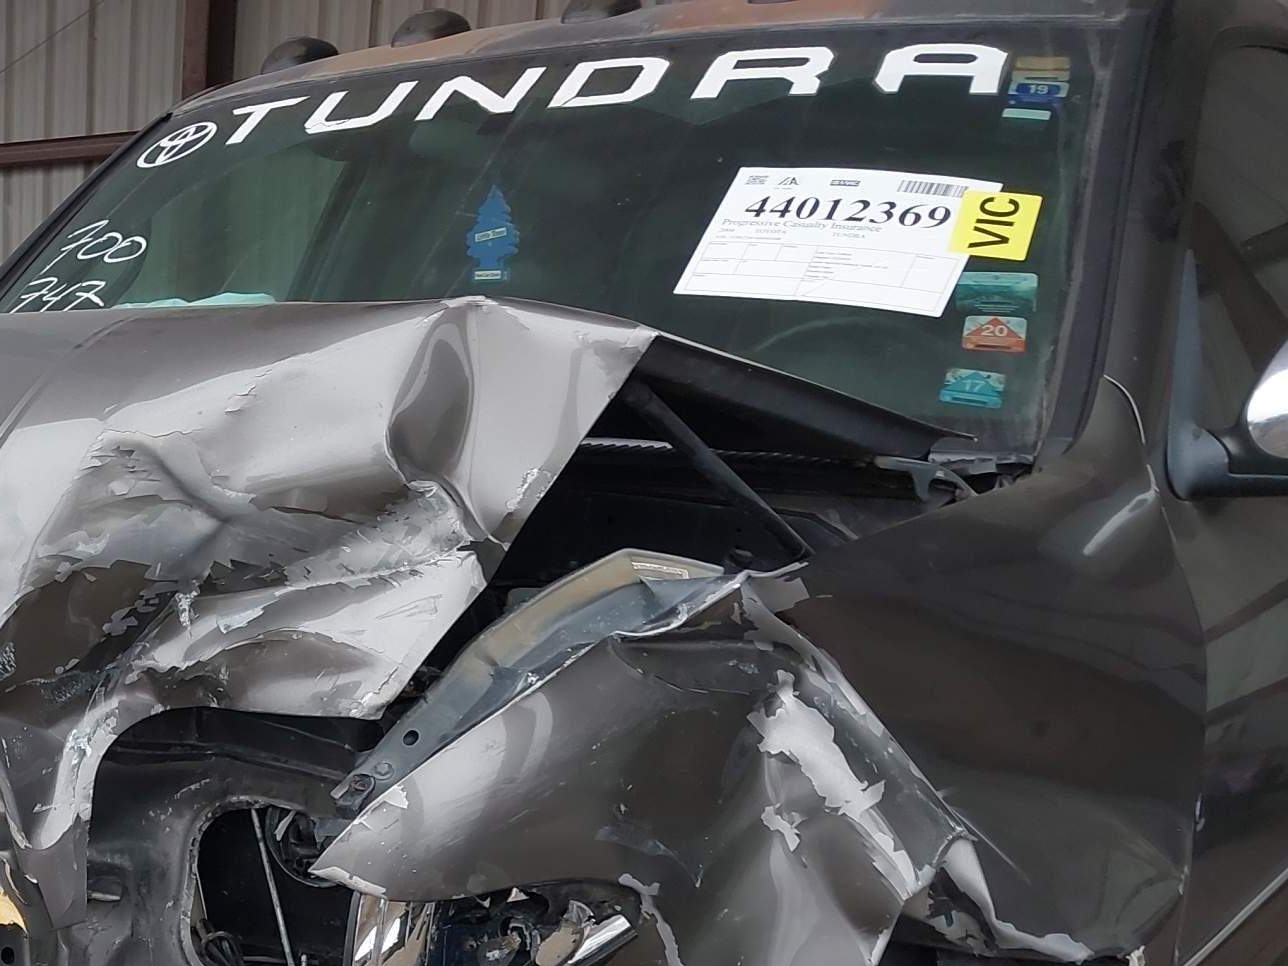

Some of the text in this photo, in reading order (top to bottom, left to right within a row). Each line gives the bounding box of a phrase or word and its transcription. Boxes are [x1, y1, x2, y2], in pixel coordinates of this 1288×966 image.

[226, 44, 1008, 146] TUNDRA
[722, 218, 882, 233] Progressive Casualty Insurance
[744, 195, 951, 229] 44012369
[967, 196, 1020, 249] VIC
[40, 219, 148, 275] 700
[10, 276, 107, 312] 747
[980, 324, 1009, 337] 20
